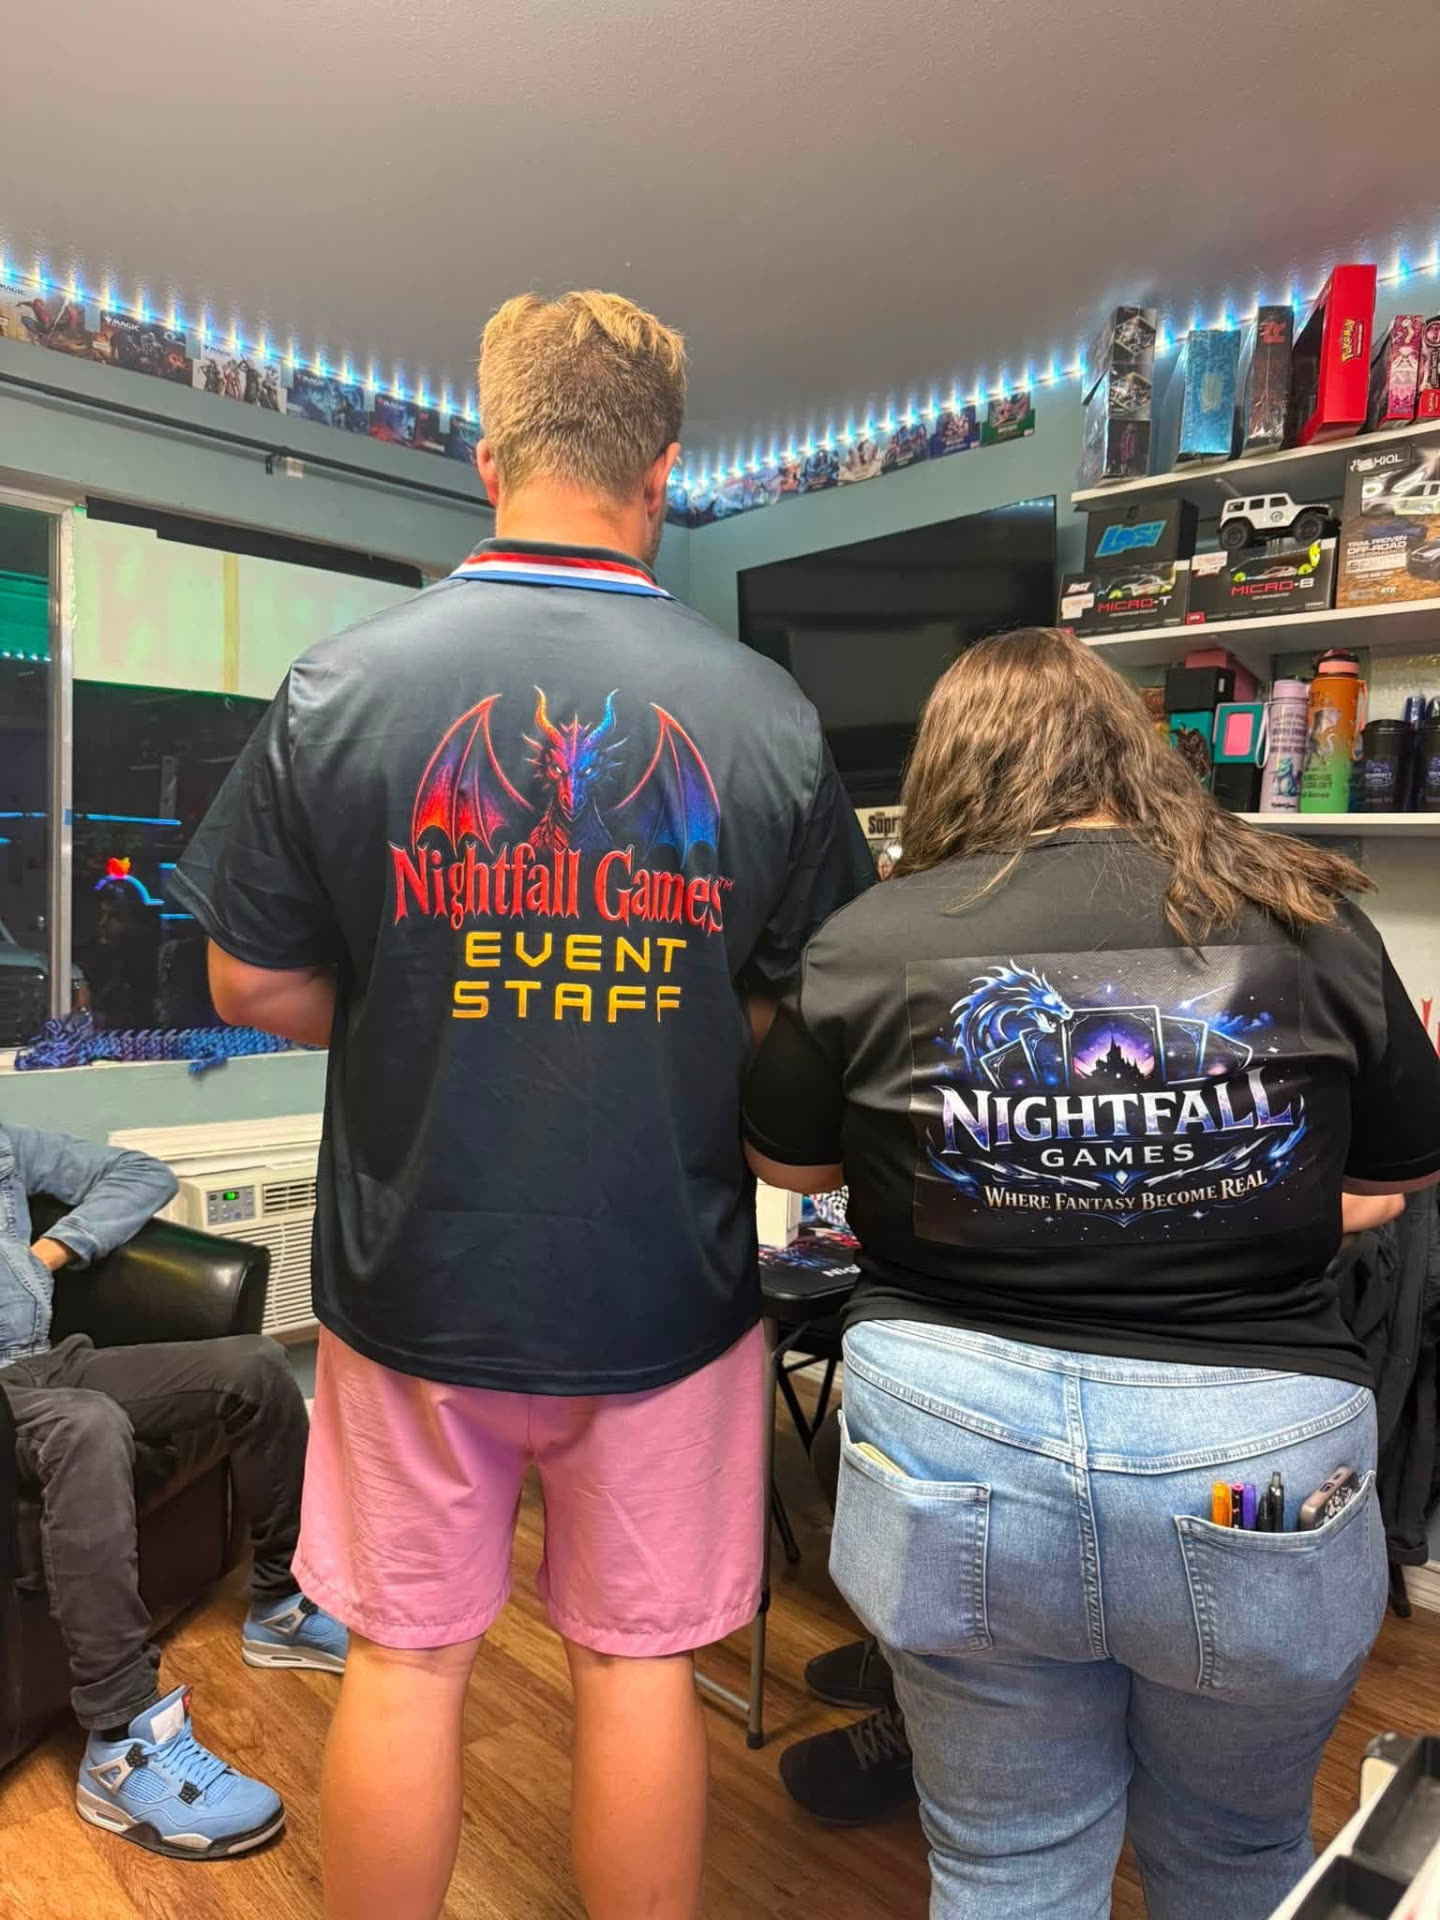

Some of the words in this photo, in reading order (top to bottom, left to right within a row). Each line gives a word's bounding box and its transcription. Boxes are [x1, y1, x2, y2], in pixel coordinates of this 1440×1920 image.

[111, 318, 141, 332] MAGIC
[1096, 595, 1172, 613] MICRO-T
[388, 841, 580, 931] Nightfall
[465, 931, 688, 974] EVENT
[451, 980, 682, 1023] STAFF
[932, 1066, 1294, 1155] NIGHTFALL
[1040, 1142, 1195, 1167] GAMES
[984, 1184, 1051, 1209] WHERE
[1055, 1192, 1137, 1212] FANTASY
[1141, 1185, 1218, 1211] BECOME
[1219, 1170, 1268, 1199] REAL
